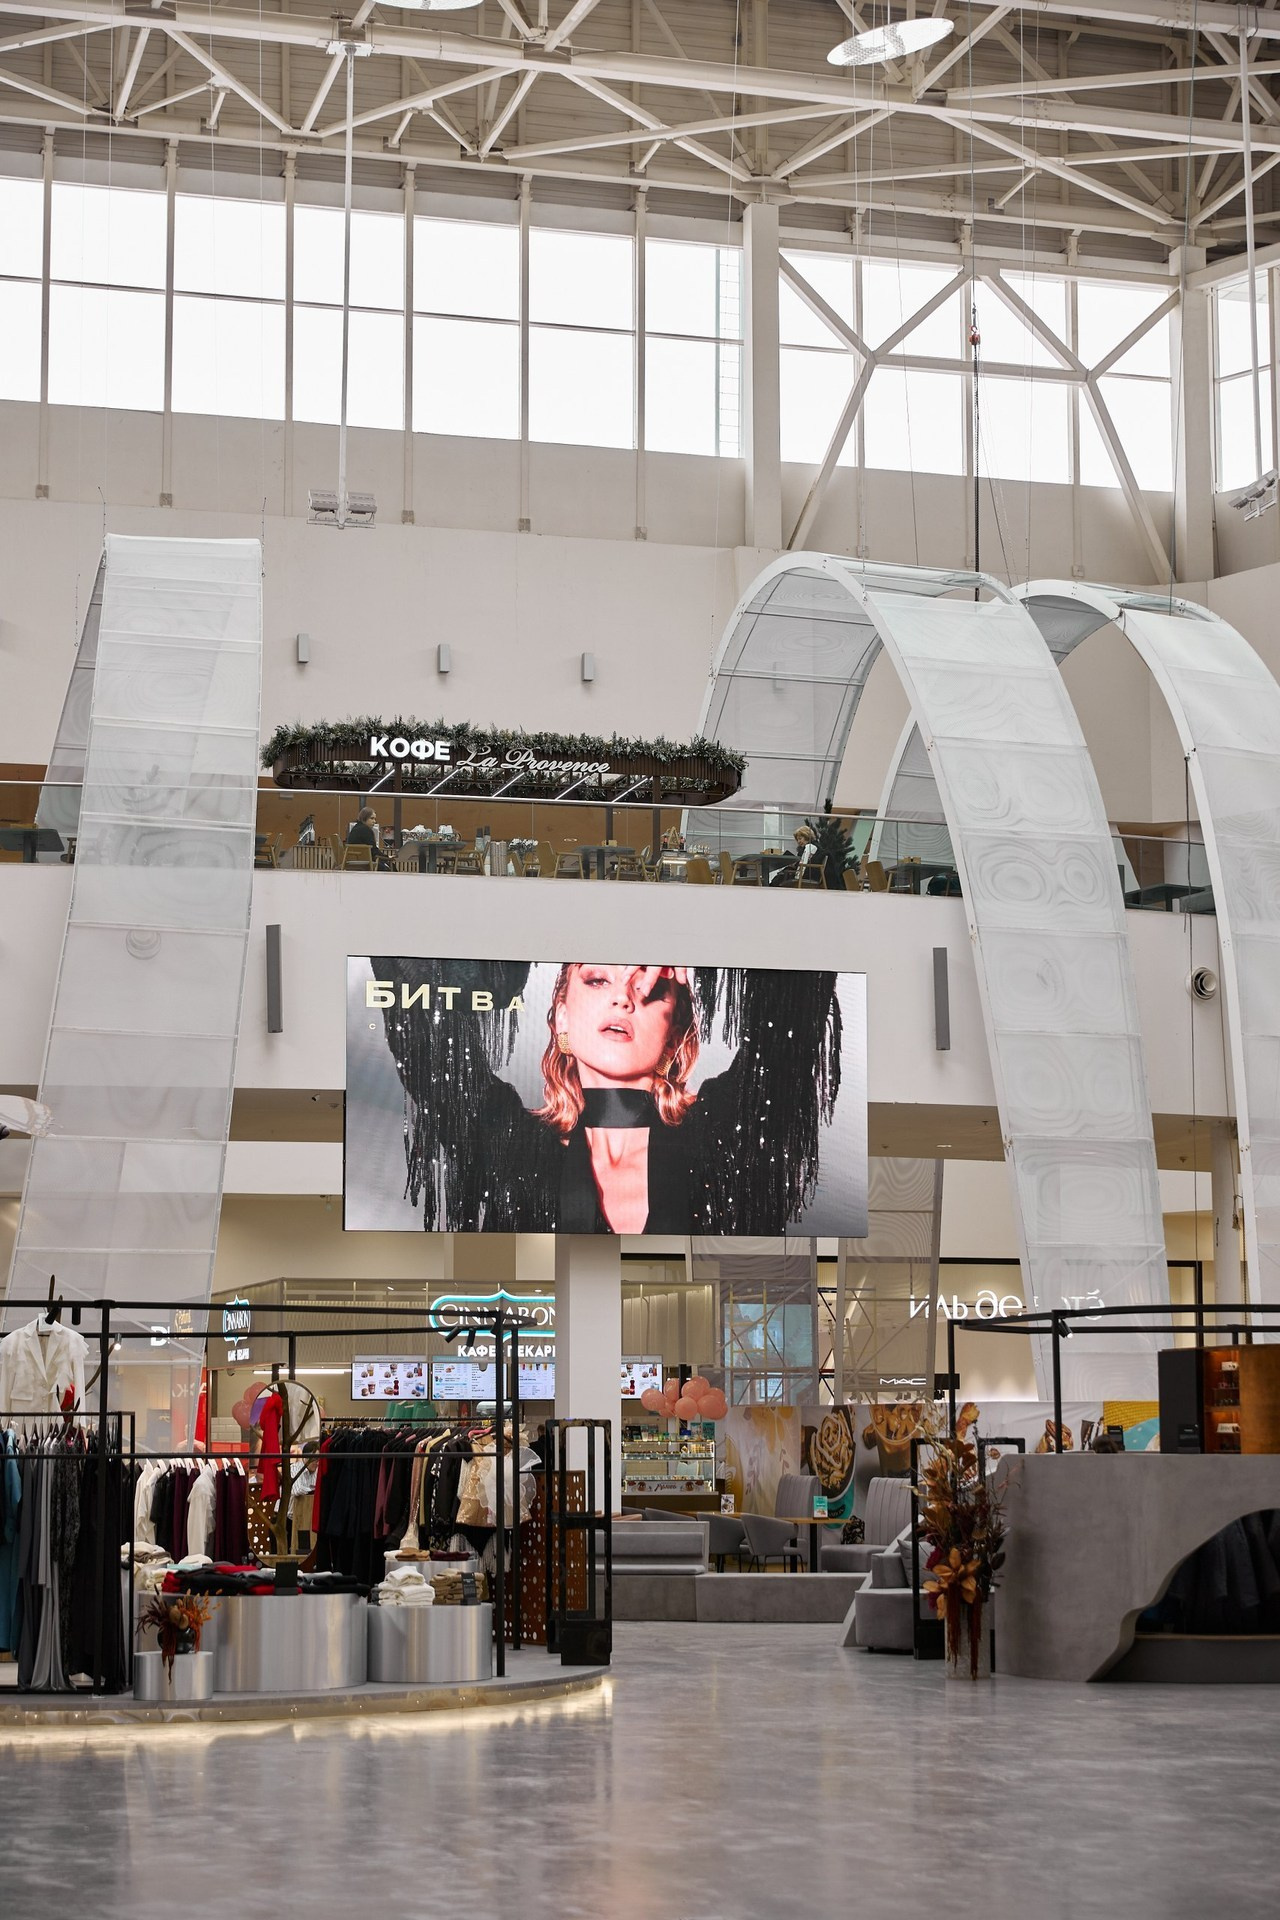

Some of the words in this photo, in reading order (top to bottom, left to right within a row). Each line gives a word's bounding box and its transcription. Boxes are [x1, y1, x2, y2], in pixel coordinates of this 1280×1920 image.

[370, 736, 451, 761] КОФЕ
[456, 745, 498, 768] La
[501, 746, 610, 773] Provence
[365, 980, 525, 1012] БИТВА
